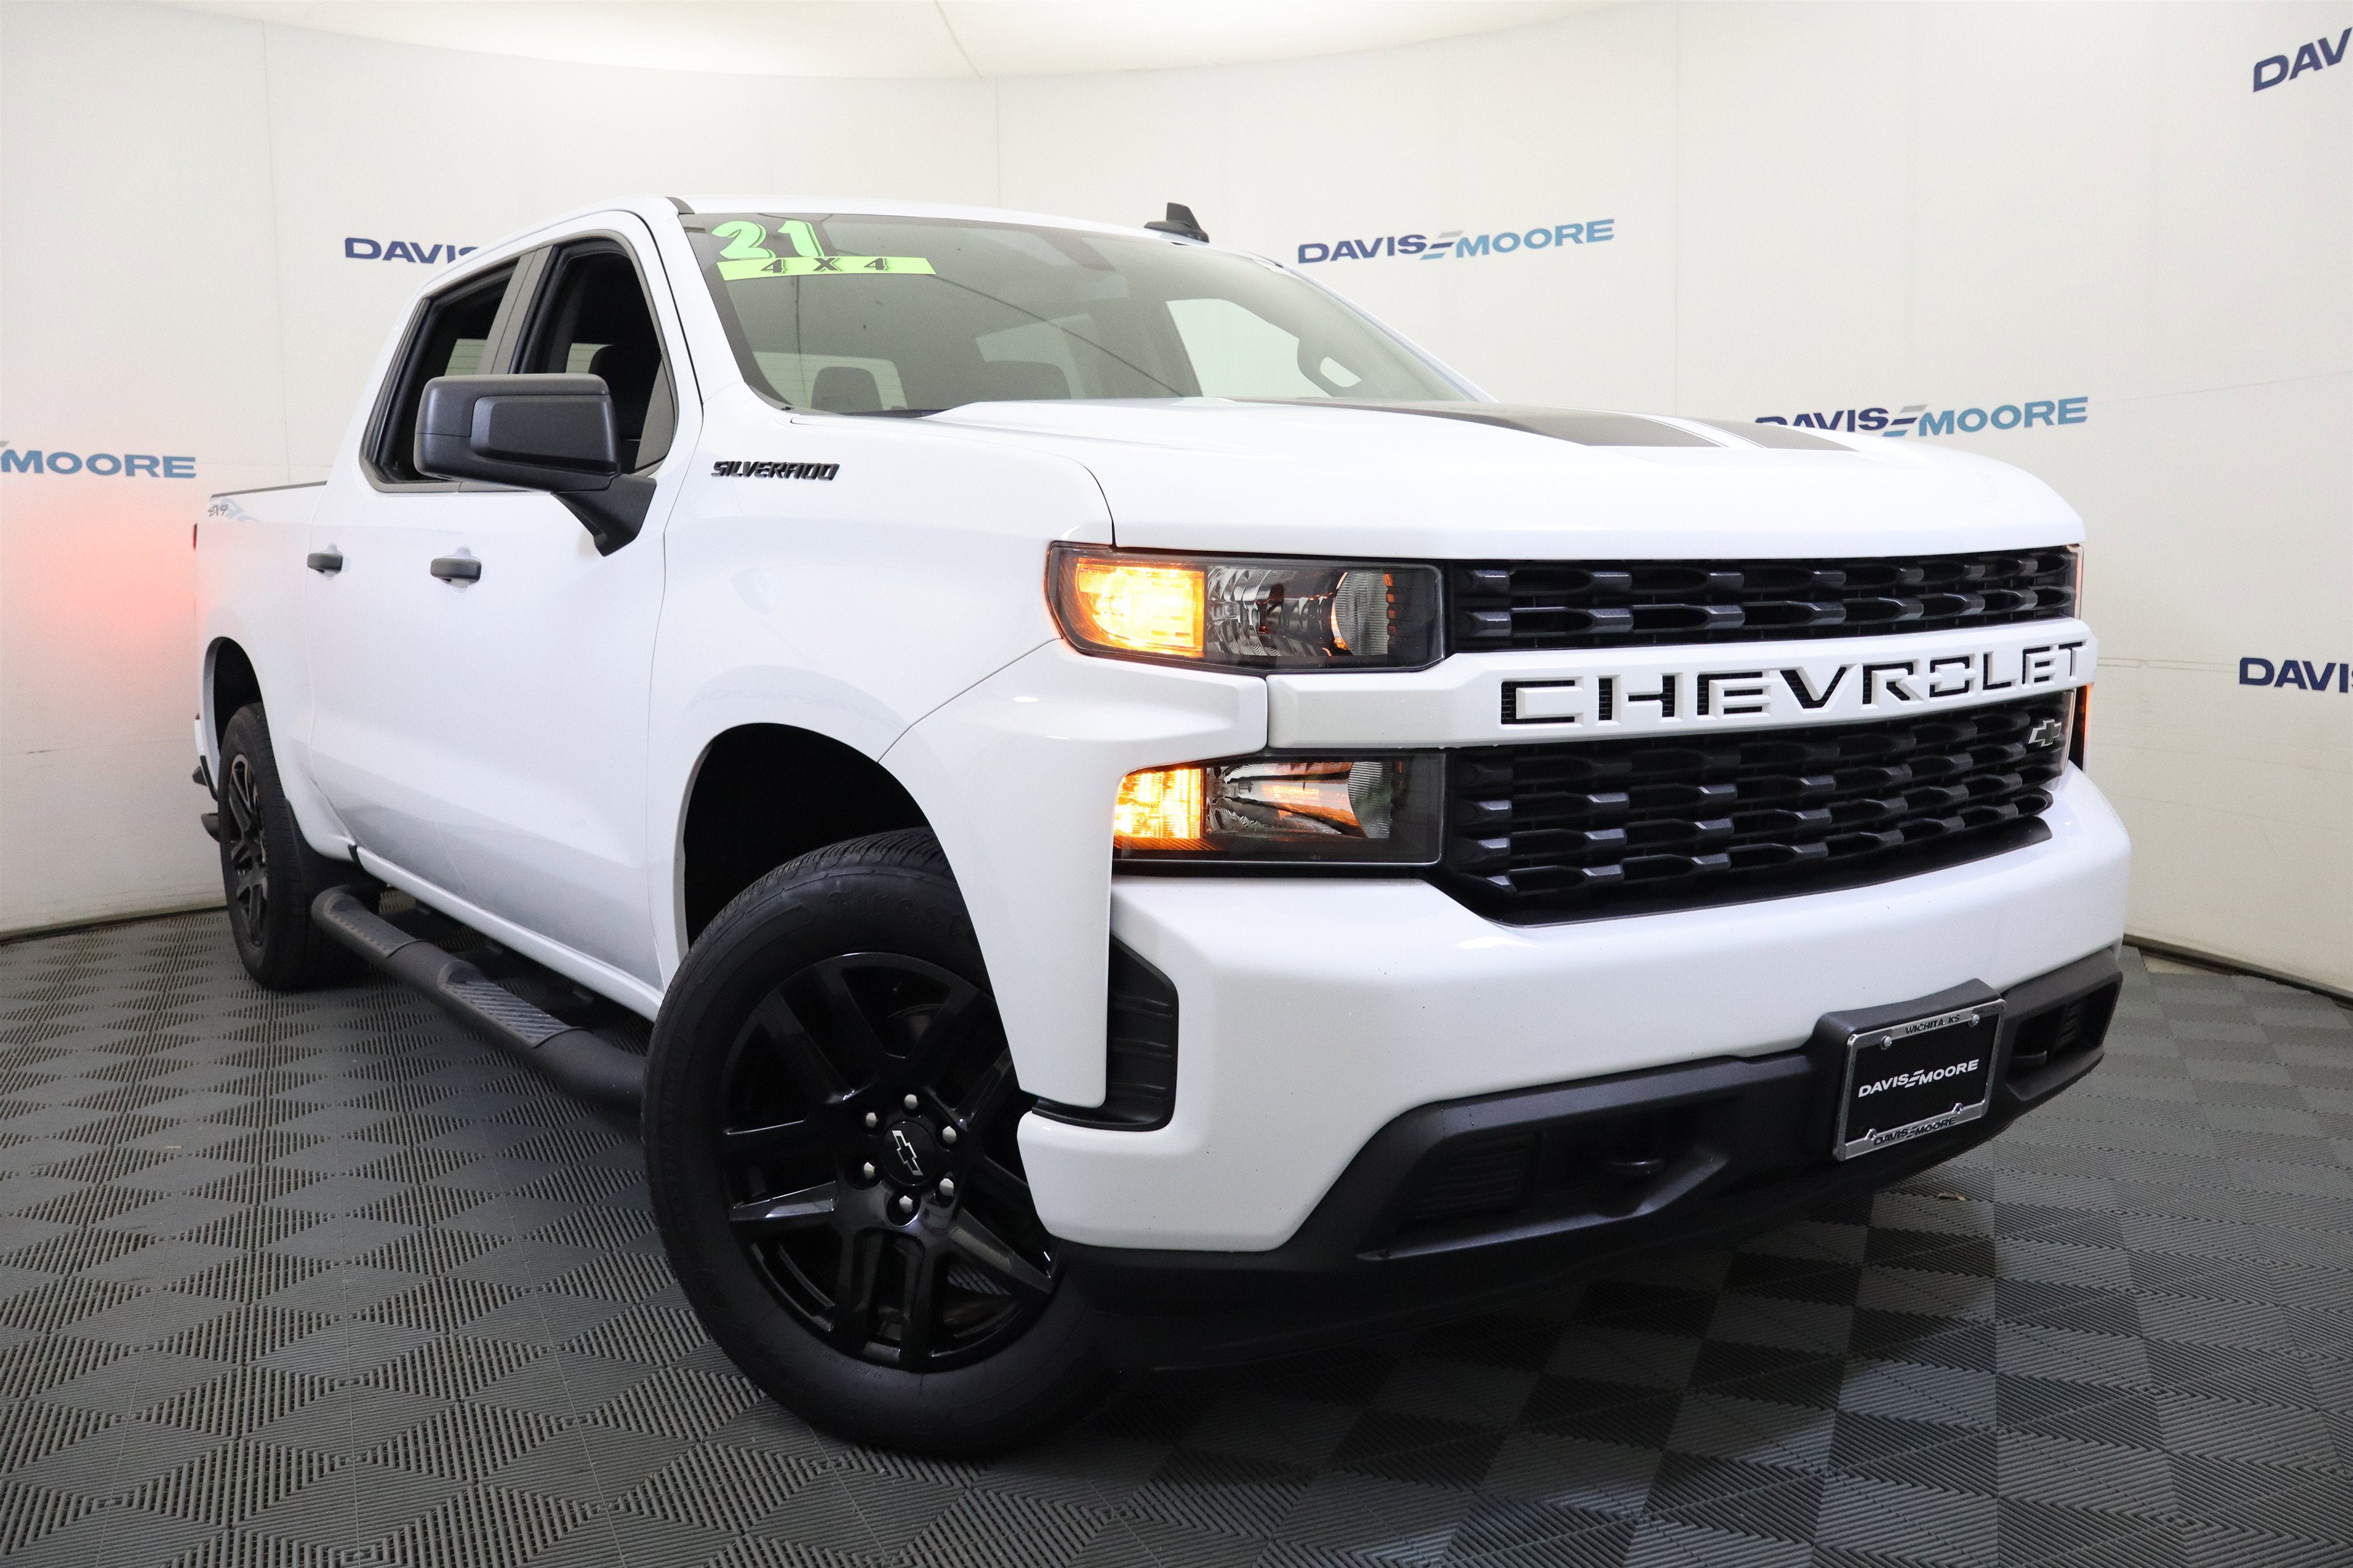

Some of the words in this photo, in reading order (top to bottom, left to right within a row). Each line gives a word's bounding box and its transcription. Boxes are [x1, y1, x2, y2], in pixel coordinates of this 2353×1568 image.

[345, 237, 479, 264] DAVI
[711, 221, 826, 260] 21
[1298, 234, 1427, 264] DAVIS
[1456, 219, 1615, 258] MOORE
[1919, 396, 2088, 437] MOORE
[1, 449, 197, 478] MOORE
[711, 461, 840, 481] SILVERADO
[207, 504, 229, 517] 4X4
[1500, 639, 2089, 728] CHEVROLET
[2239, 657, 2353, 693] DAVI
[1948, 1015, 1960, 1024] KS
[1858, 1073, 1910, 1098] DAVIS
[1919, 1059, 1979, 1085] MOORE
[1874, 1129, 1908, 1145] DAVIS
[1915, 1117, 1957, 1136] MOORE
